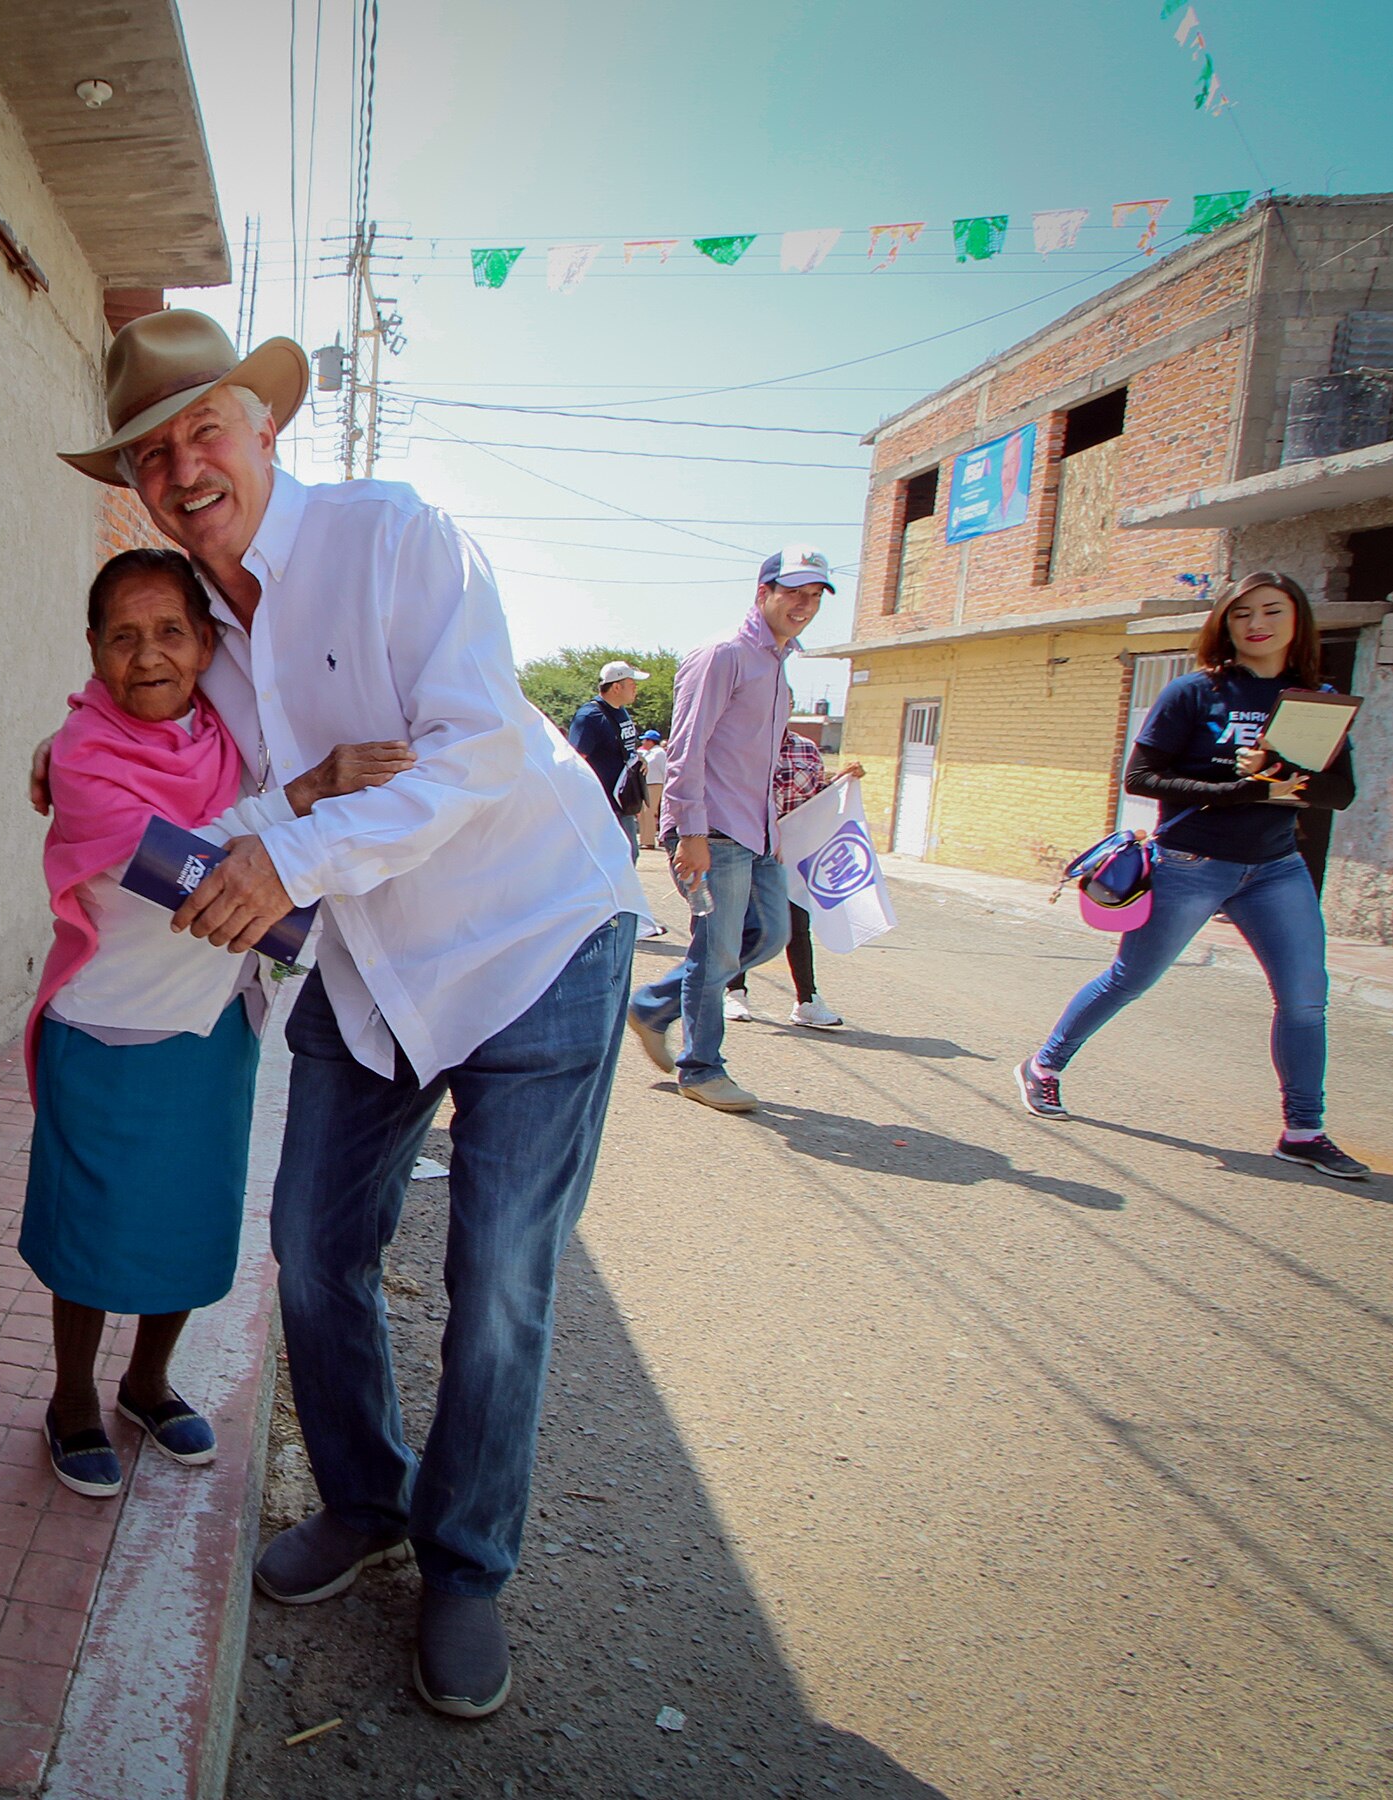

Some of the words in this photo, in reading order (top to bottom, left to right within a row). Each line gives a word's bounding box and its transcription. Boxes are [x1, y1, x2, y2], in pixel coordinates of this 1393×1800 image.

[1228, 711, 1270, 722] ENRI
[1206, 721, 1264, 746] VE
[1211, 757, 1236, 765] PRES
[176, 854, 195, 885] ENRIQUE
[820, 842, 864, 890] PAN
